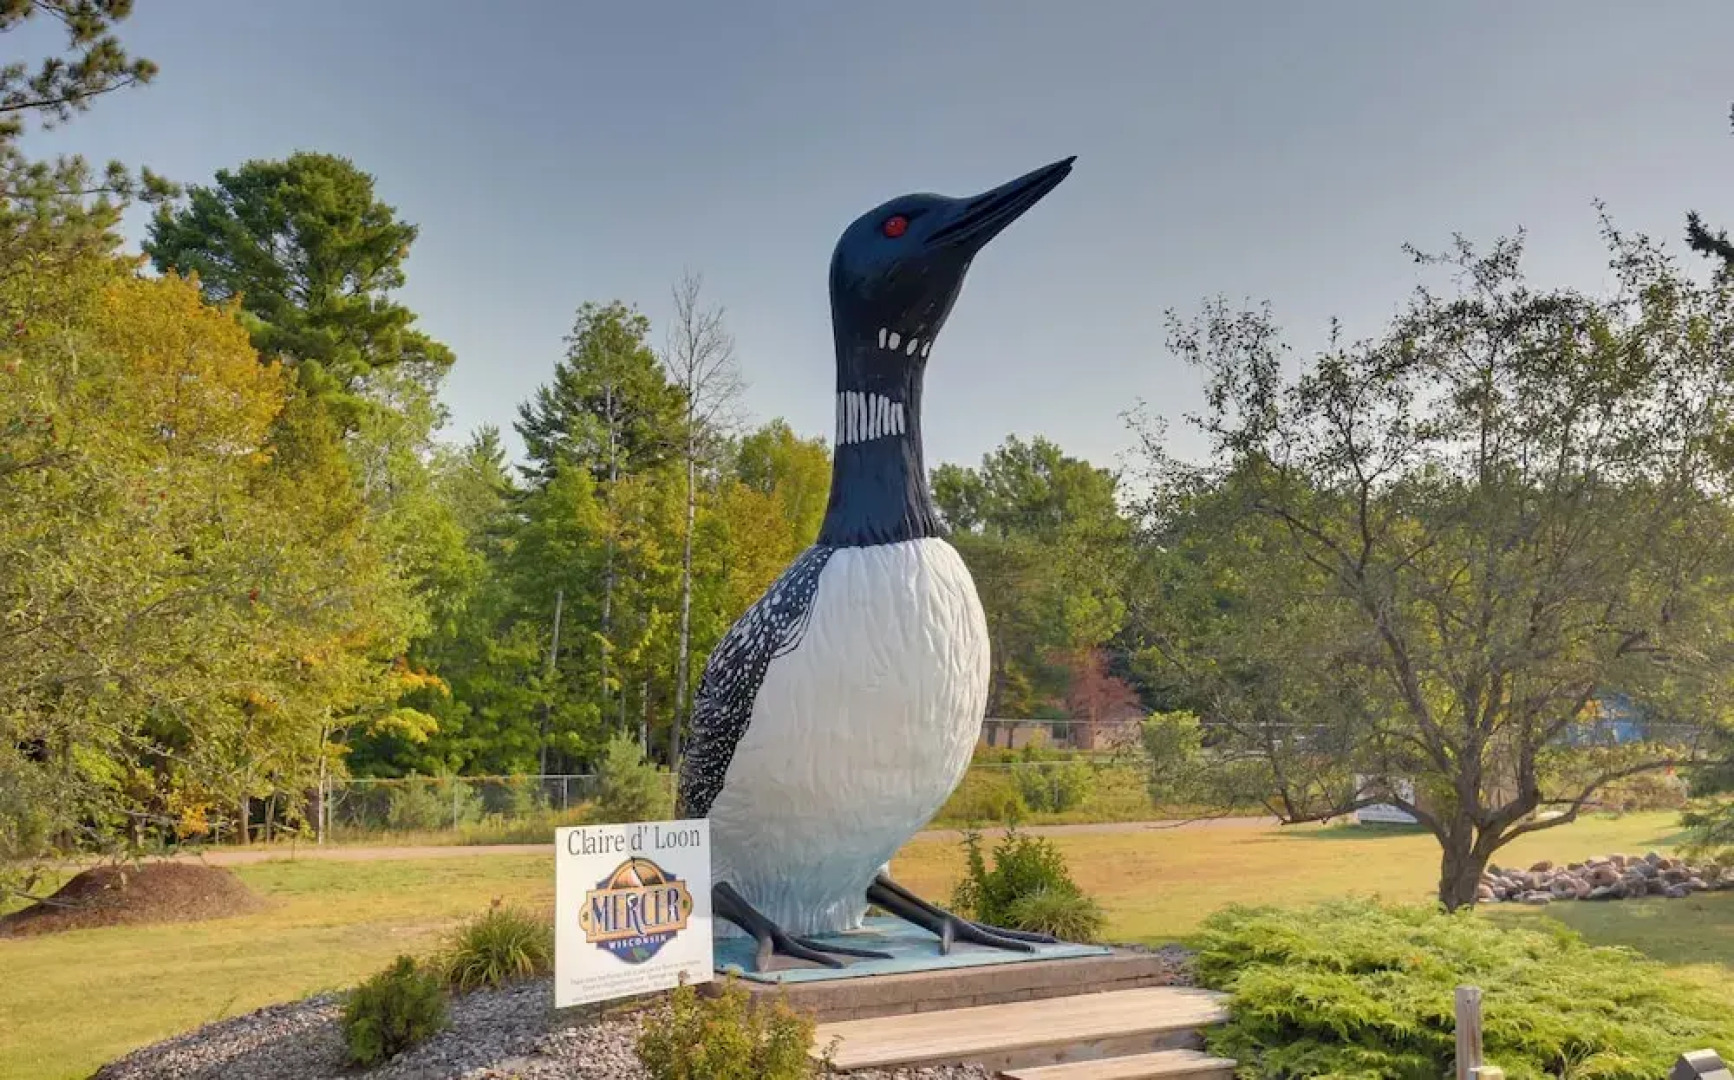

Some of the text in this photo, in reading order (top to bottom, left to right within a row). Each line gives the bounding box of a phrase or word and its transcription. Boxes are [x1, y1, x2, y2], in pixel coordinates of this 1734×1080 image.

[568, 825, 701, 855] Claire d' Loon
[592, 888, 681, 936] MERCER
[608, 934, 667, 949] WISCONSIN
